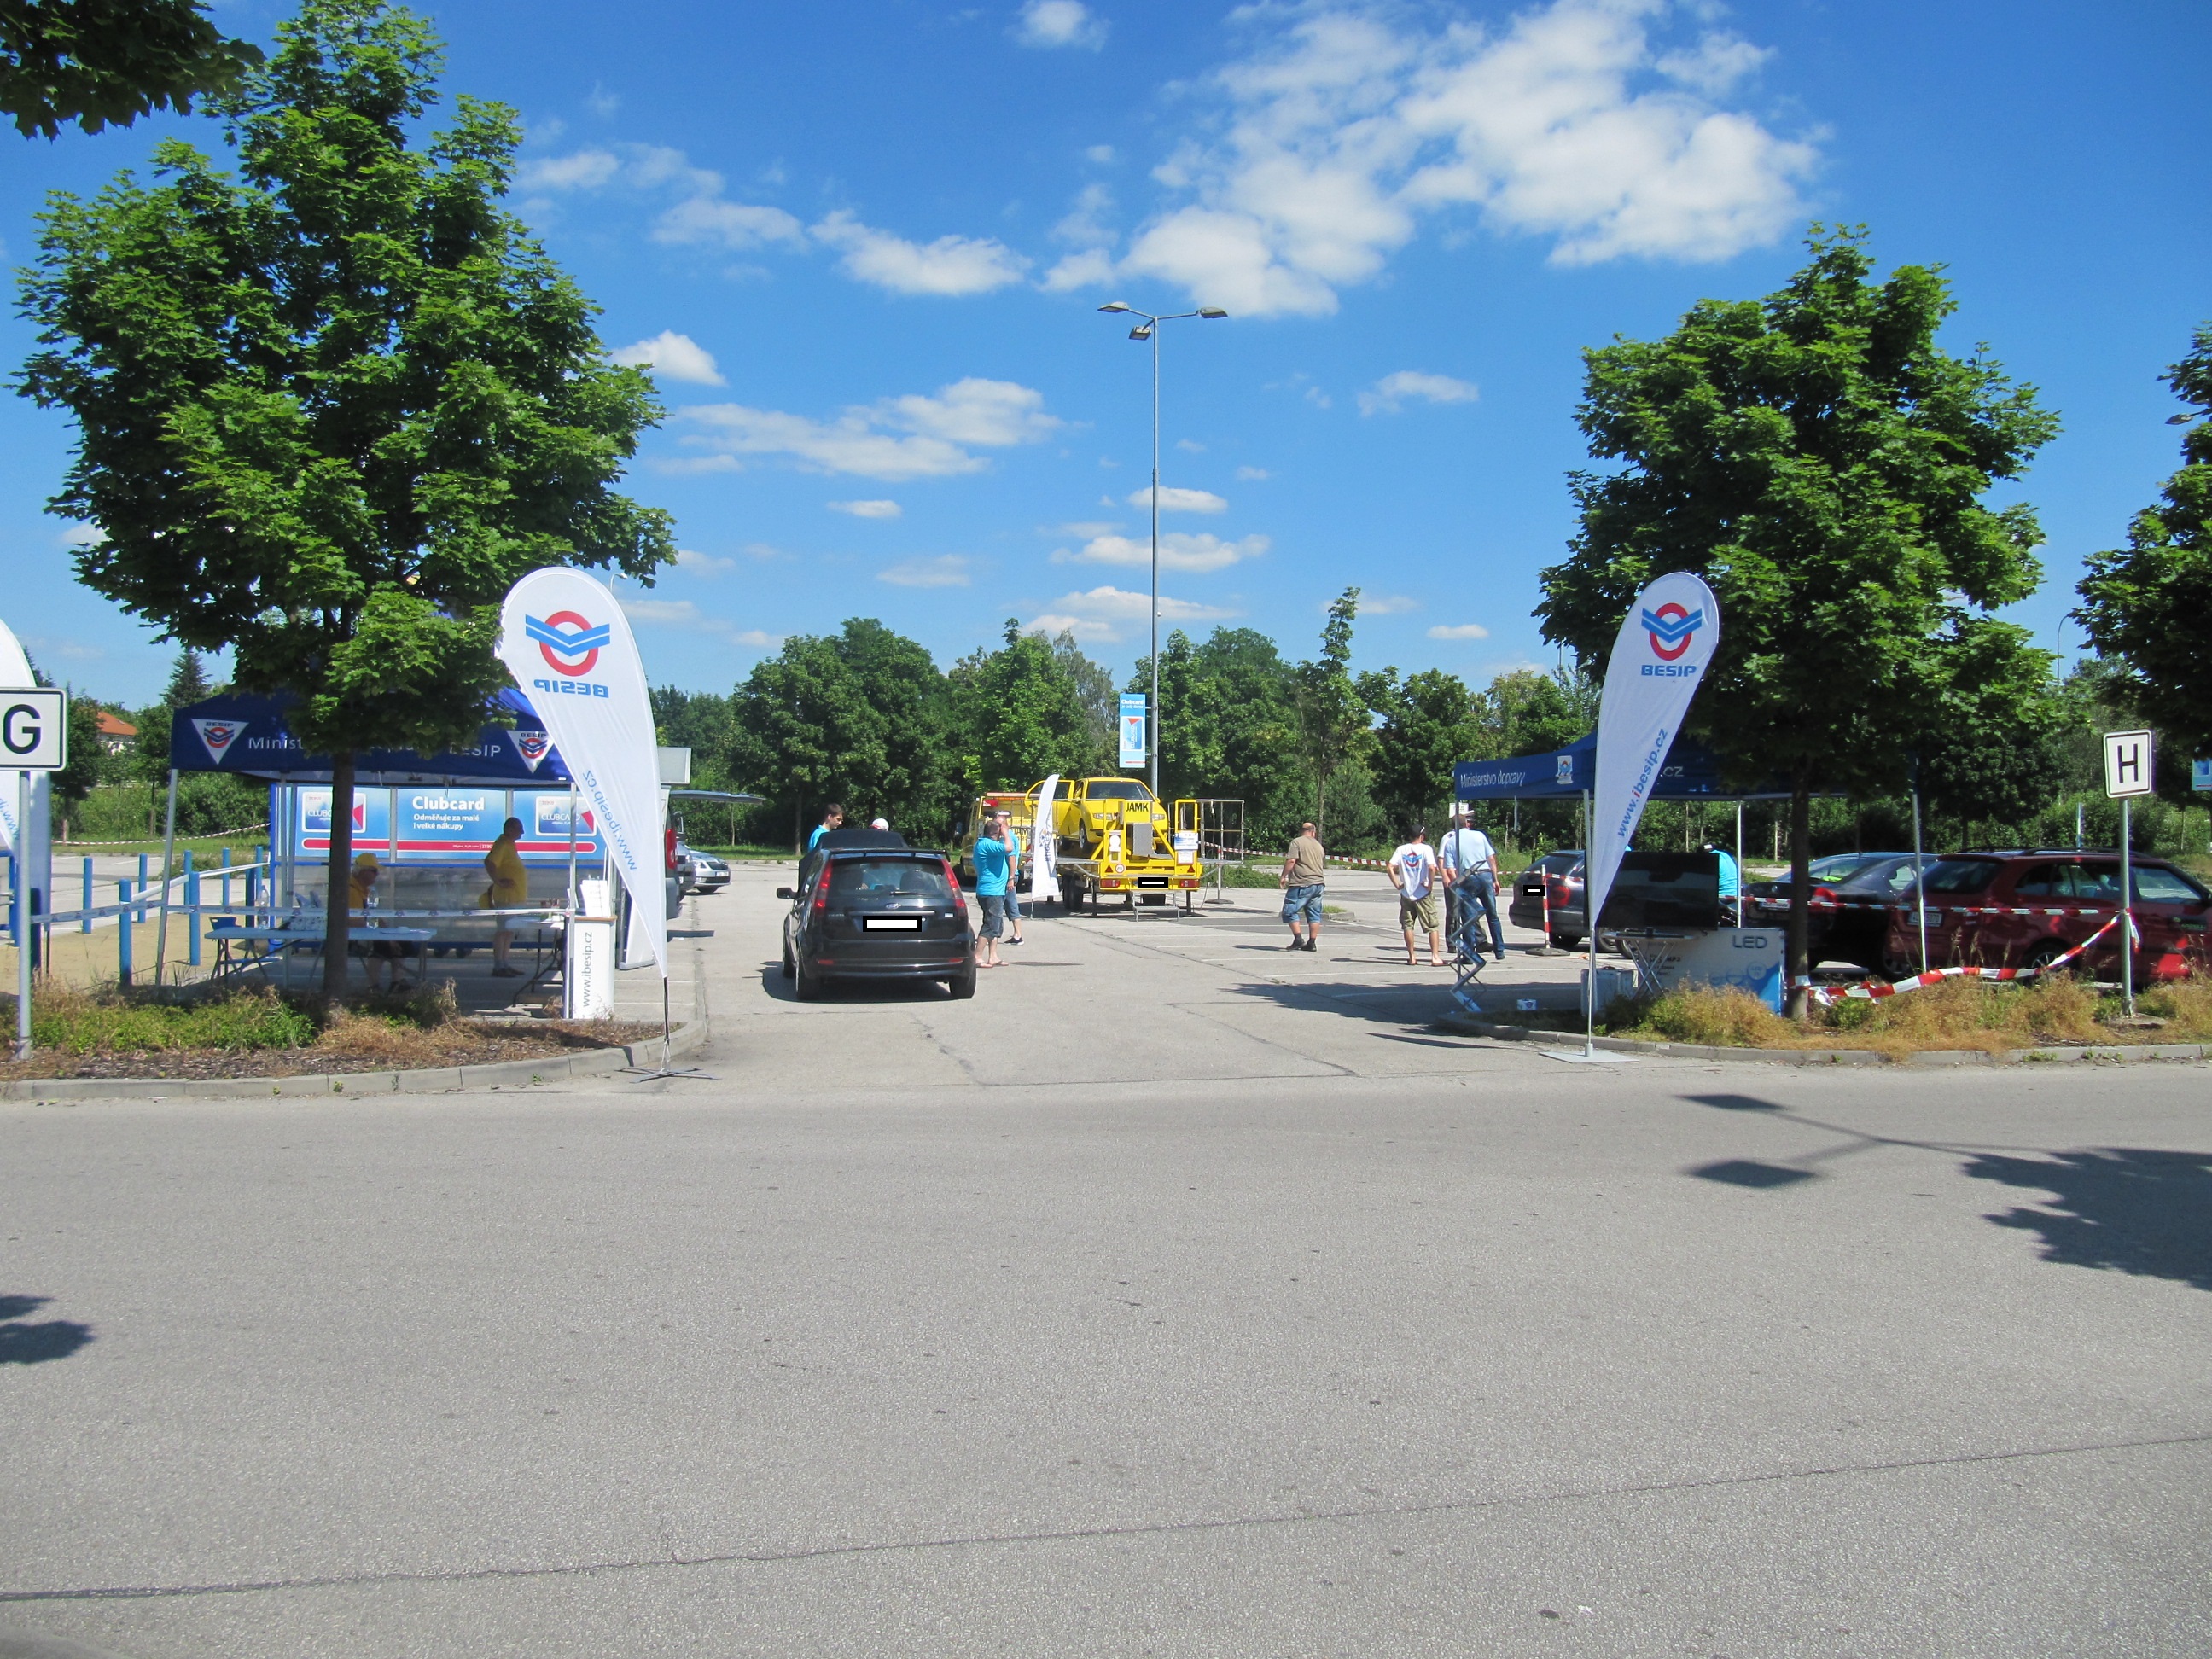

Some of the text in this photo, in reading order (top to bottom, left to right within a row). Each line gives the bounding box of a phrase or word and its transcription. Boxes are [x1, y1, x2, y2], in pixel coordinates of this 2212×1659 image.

[1640, 664, 1697, 678] BESIP
[3, 704, 42, 754] G
[2117, 743, 2139, 783] H
[1460, 769, 1526, 788] Ministerstvo dopravy
[1617, 728, 1668, 837] www.ibesip.cz
[412, 795, 485, 810] Clubcard
[1126, 802, 1149, 812] JAMK
[413, 813, 451, 823] Odměňuje
[462, 813, 480, 822] malé
[1732, 934, 1768, 949] LED
[581, 931, 595, 1008] www.ibesip.cz
